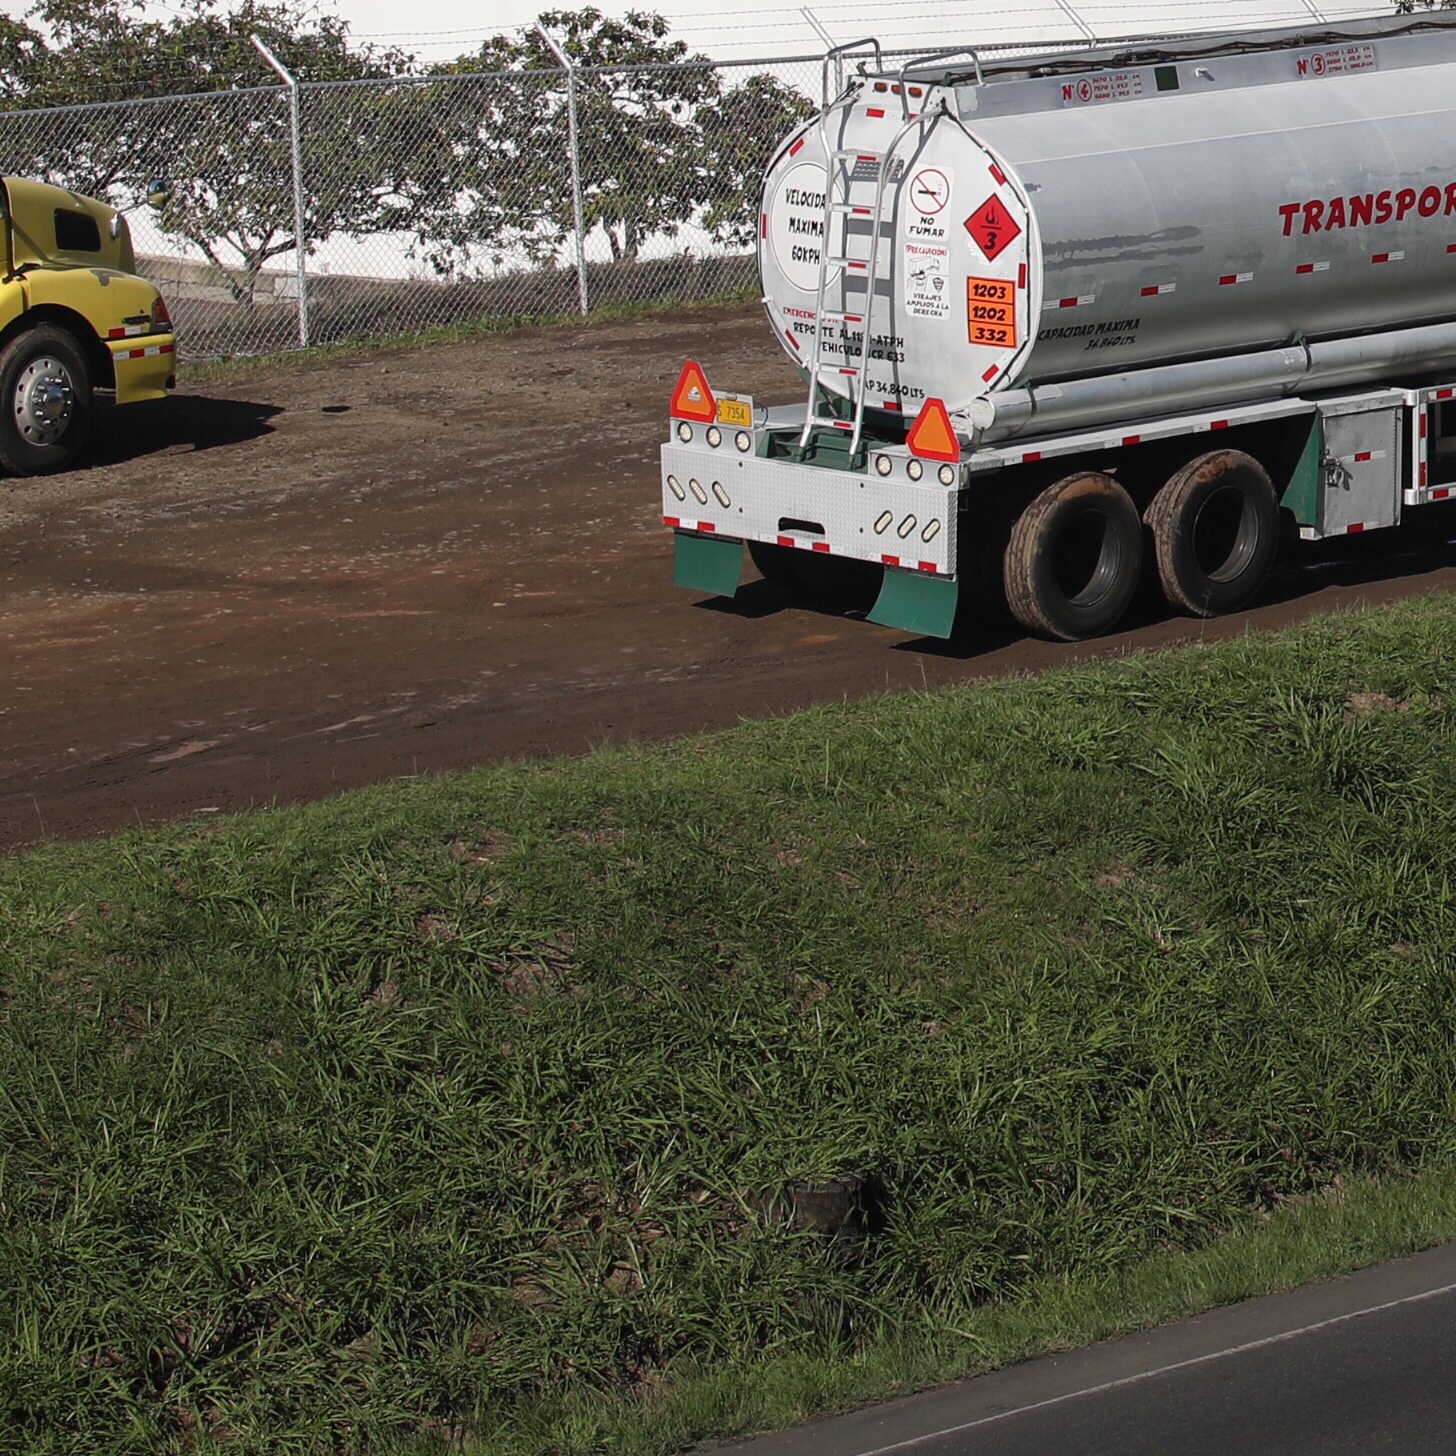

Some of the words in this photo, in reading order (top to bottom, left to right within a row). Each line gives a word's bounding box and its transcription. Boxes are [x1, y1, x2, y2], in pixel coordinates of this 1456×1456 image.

[1314, 56, 1323, 73] 3
[1080, 83, 1089, 98] 4
[785, 187, 826, 210] VELOCIDA
[919, 216, 935, 226] NO
[908, 226, 946, 238] FUMAR
[983, 231, 998, 251] 3
[913, 292, 942, 302] VIRAJES
[972, 283, 1007, 300] 1203
[906, 300, 936, 310] AMPLIOS
[912, 307, 943, 318] DERECHA
[972, 305, 1006, 322] 1202
[793, 321, 834, 339] REPOTE
[974, 327, 1008, 343] 332
[1037, 324, 1093, 341] CAPACIDAD
[1095, 318, 1140, 335] MAXIMA
[821, 341, 862, 358] EHICULO
[886, 349, 905, 363] 633
[909, 388, 925, 399] LTS
[726, 406, 745, 421] 7354
